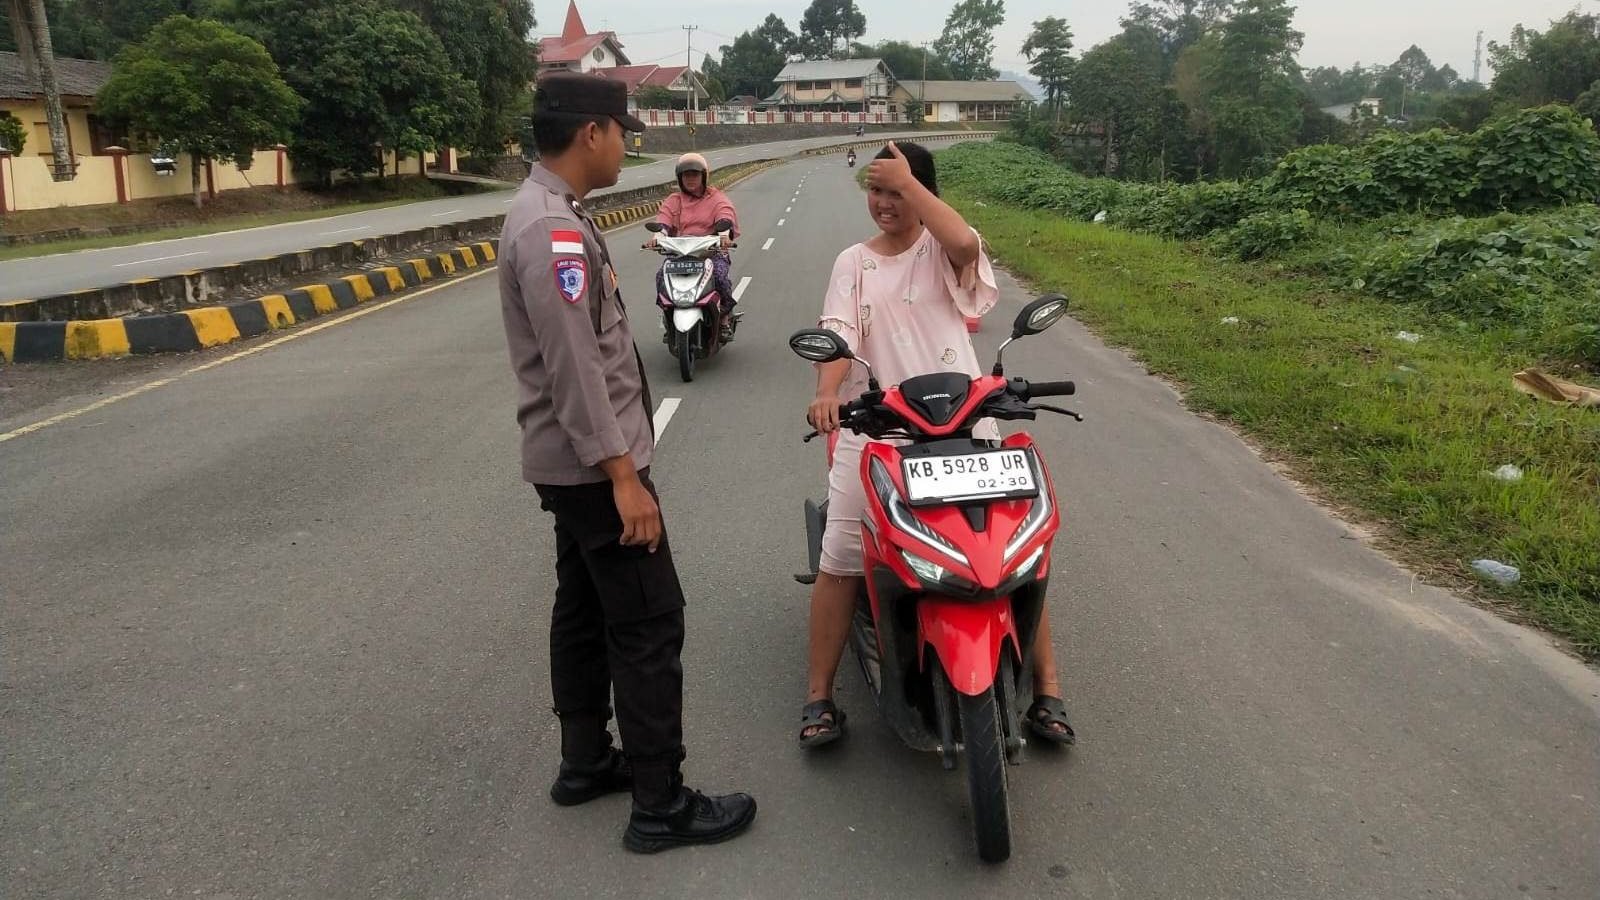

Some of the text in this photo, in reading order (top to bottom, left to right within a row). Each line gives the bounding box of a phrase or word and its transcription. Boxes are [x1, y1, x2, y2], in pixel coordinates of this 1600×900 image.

[922, 393, 951, 401] HONDA
[909, 454, 1025, 479] KB 5928 UR
